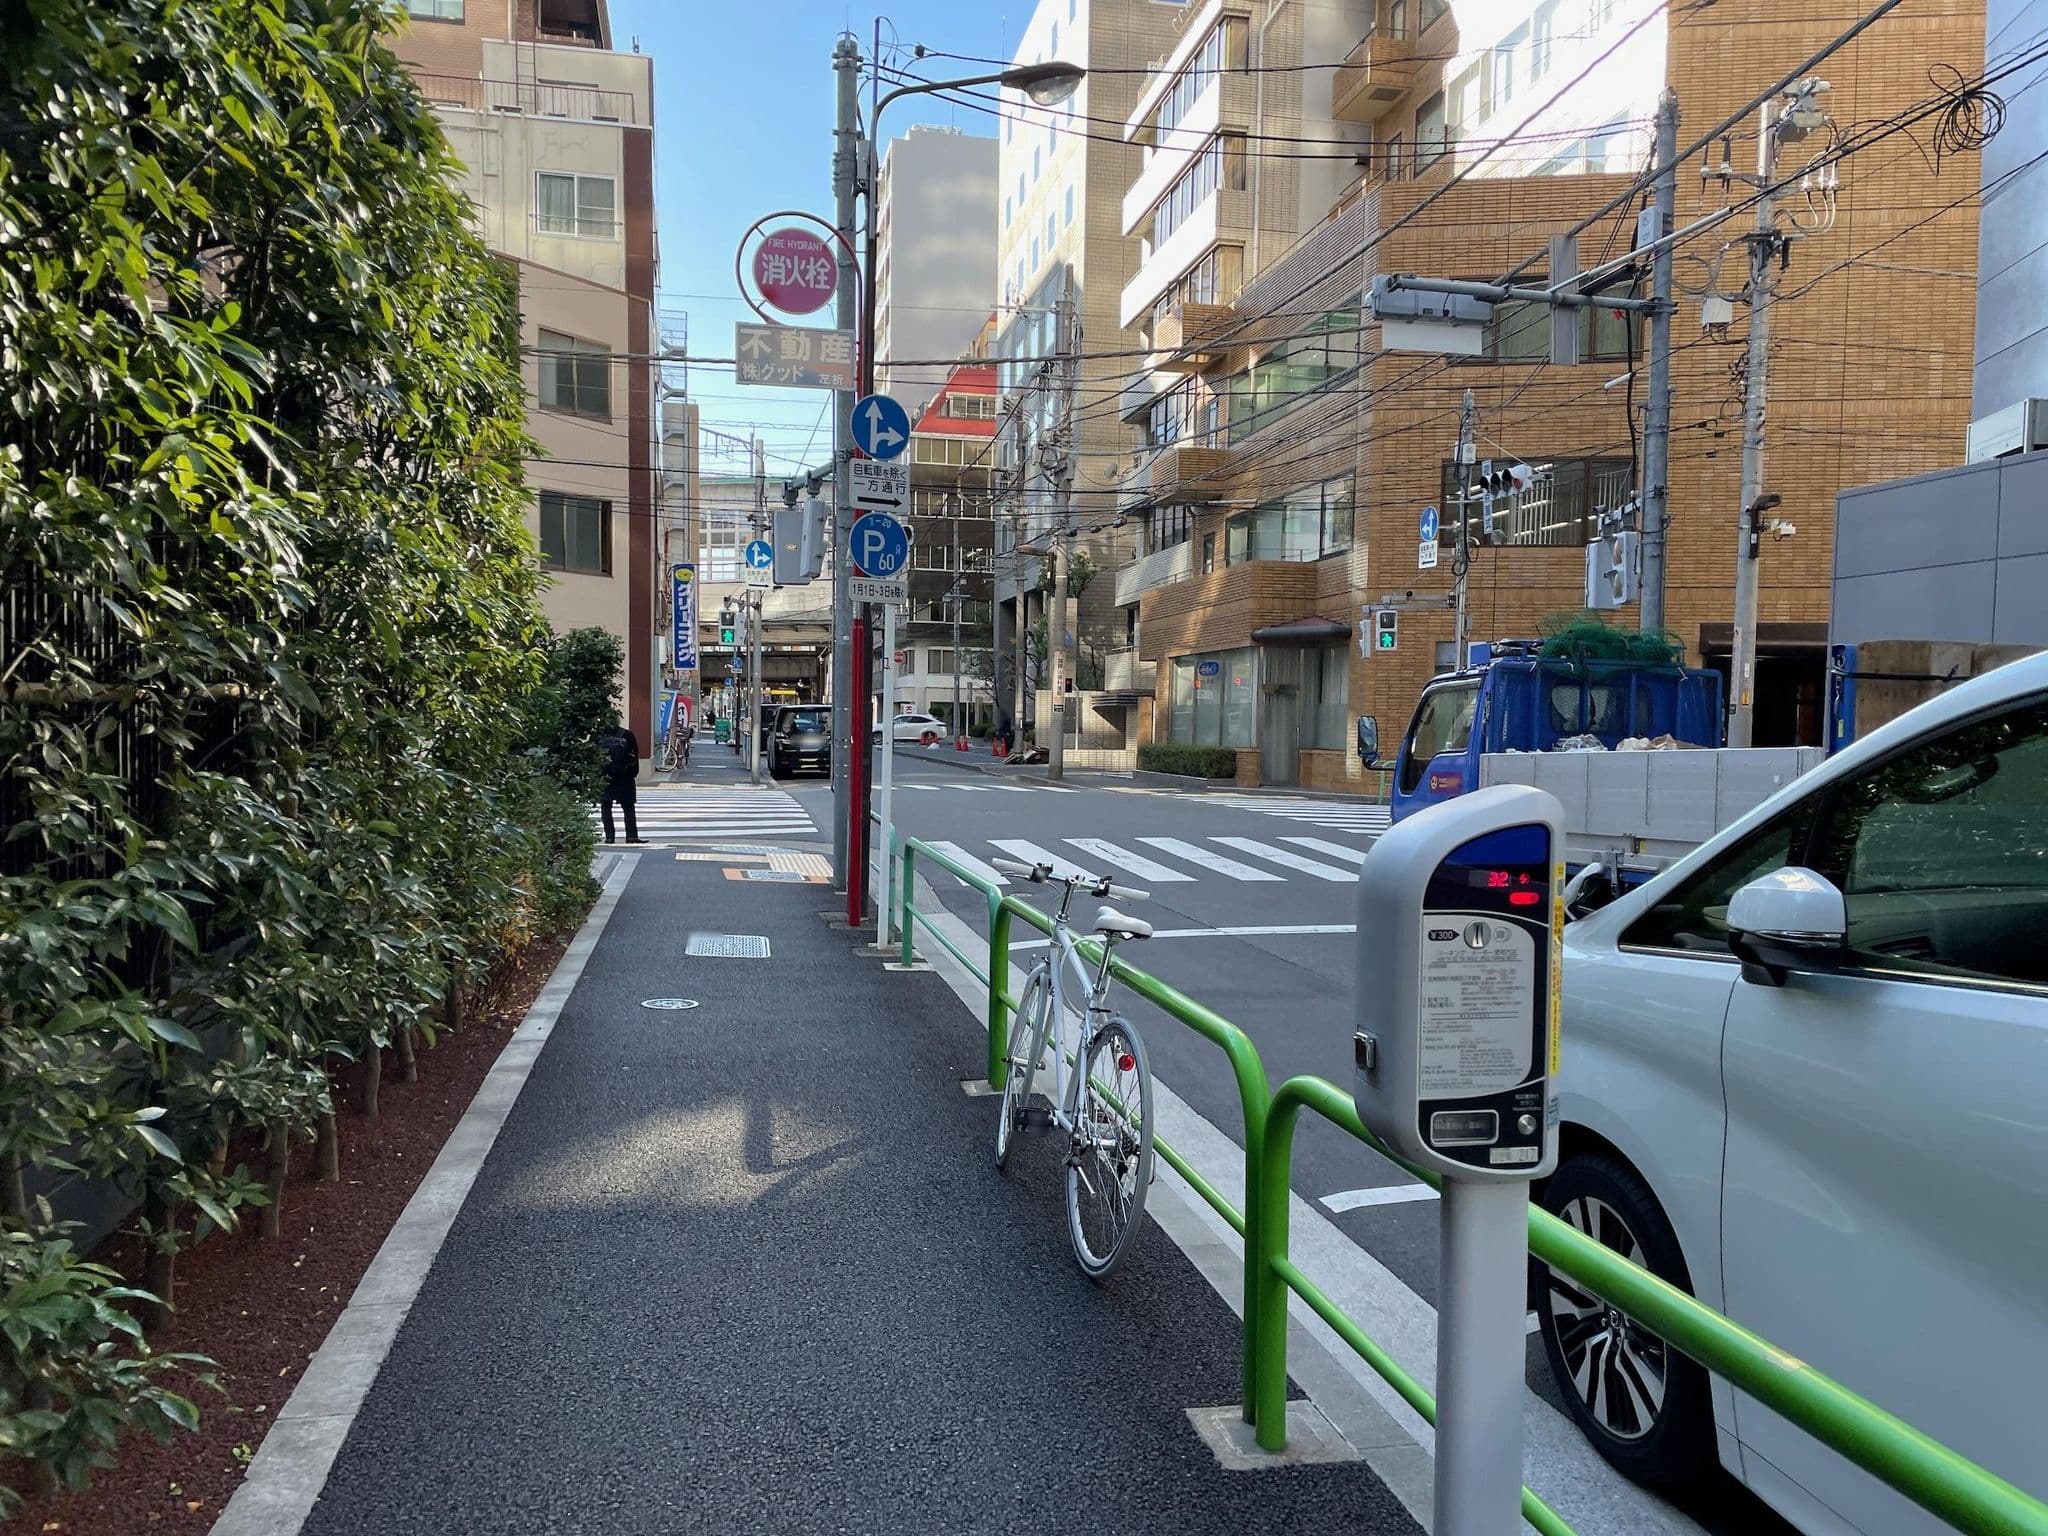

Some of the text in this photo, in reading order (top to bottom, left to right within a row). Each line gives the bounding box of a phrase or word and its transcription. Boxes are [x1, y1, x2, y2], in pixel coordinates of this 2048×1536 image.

[767, 238, 823, 252] FIRE HYDRANT
[761, 252, 832, 290] 消火栓
[740, 328, 850, 364] 不動産
[817, 373, 845, 386] 左折
[853, 463, 907, 480] 自転車を除く
[853, 480, 907, 496] 一方通行
[863, 529, 886, 569] P
[878, 553, 895, 571] 60
[677, 583, 696, 665] クリーニング
